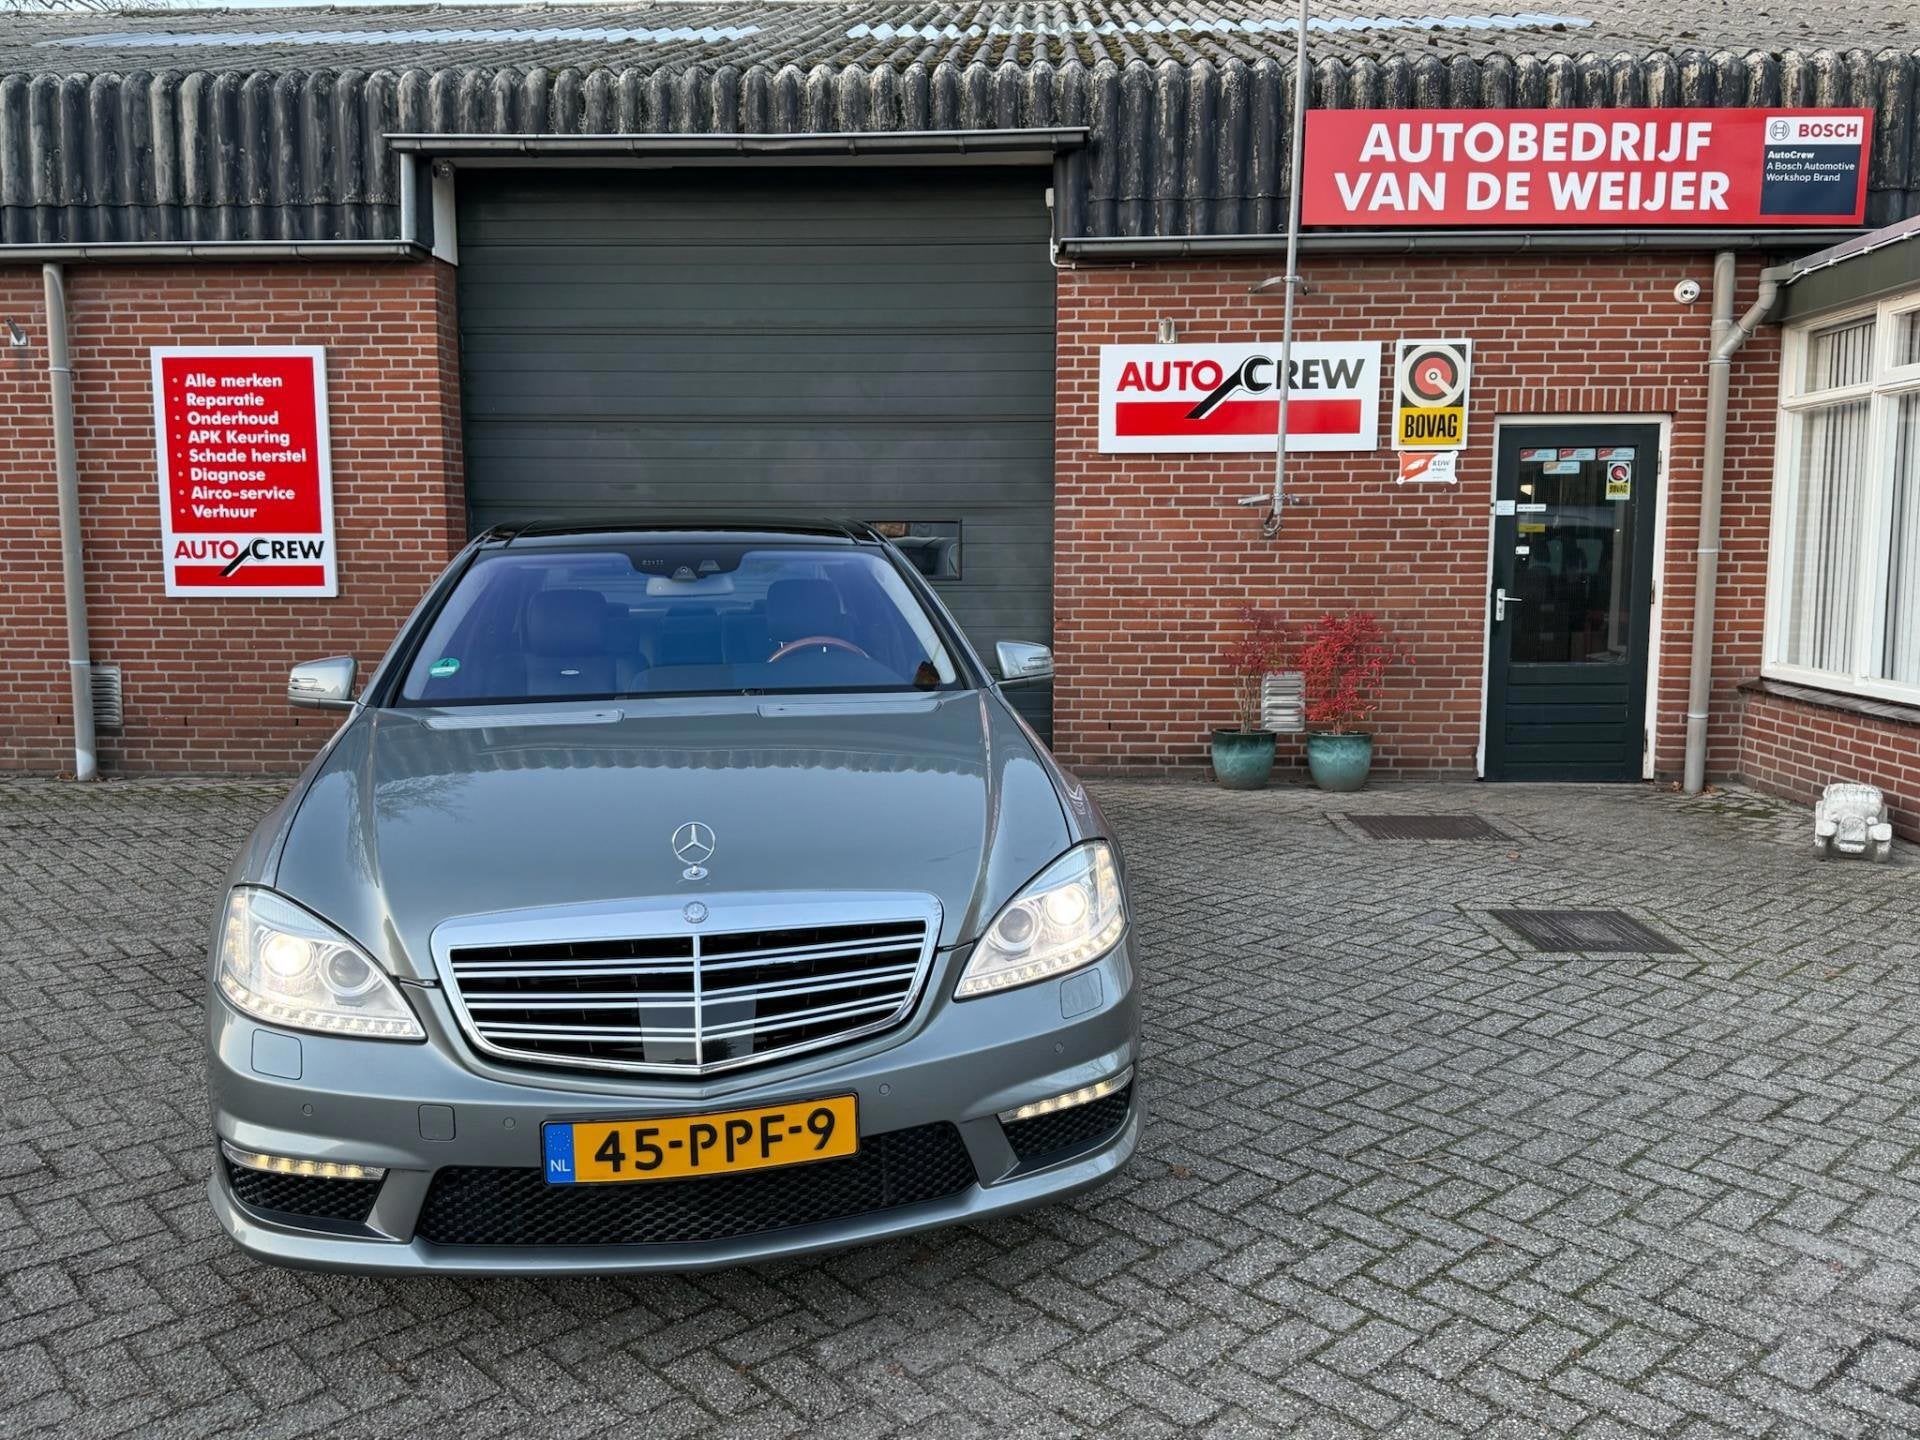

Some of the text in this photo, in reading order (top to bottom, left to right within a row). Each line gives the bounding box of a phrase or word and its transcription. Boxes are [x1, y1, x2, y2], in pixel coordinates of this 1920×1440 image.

[1798, 123, 1858, 138] BOSCH
[1358, 121, 1713, 162] AUTOBEDRIJF
[1767, 150, 1815, 159] AutoCrew
[1766, 161, 1856, 171] A Bosch Automotive
[1766, 173, 1841, 183] Workshop Brand
[1334, 170, 1730, 212] VAN DE WEIJER
[184, 373, 283, 388] Alle merken
[1116, 357, 1366, 392] AUTO CREW
[185, 392, 265, 409] Reparatie
[187, 411, 279, 425] Onderhoud
[1405, 414, 1458, 438] BOVAG
[188, 430, 291, 447] APK Keuring
[189, 448, 307, 463] Schade herstel
[190, 467, 266, 484] Diagnose
[191, 486, 296, 500] Airco-service
[191, 504, 257, 519] Verhuur
[174, 538, 325, 560] AUTO CREW
[594, 1107, 835, 1173] 45-PPF-9
[550, 1159, 571, 1173] NL
